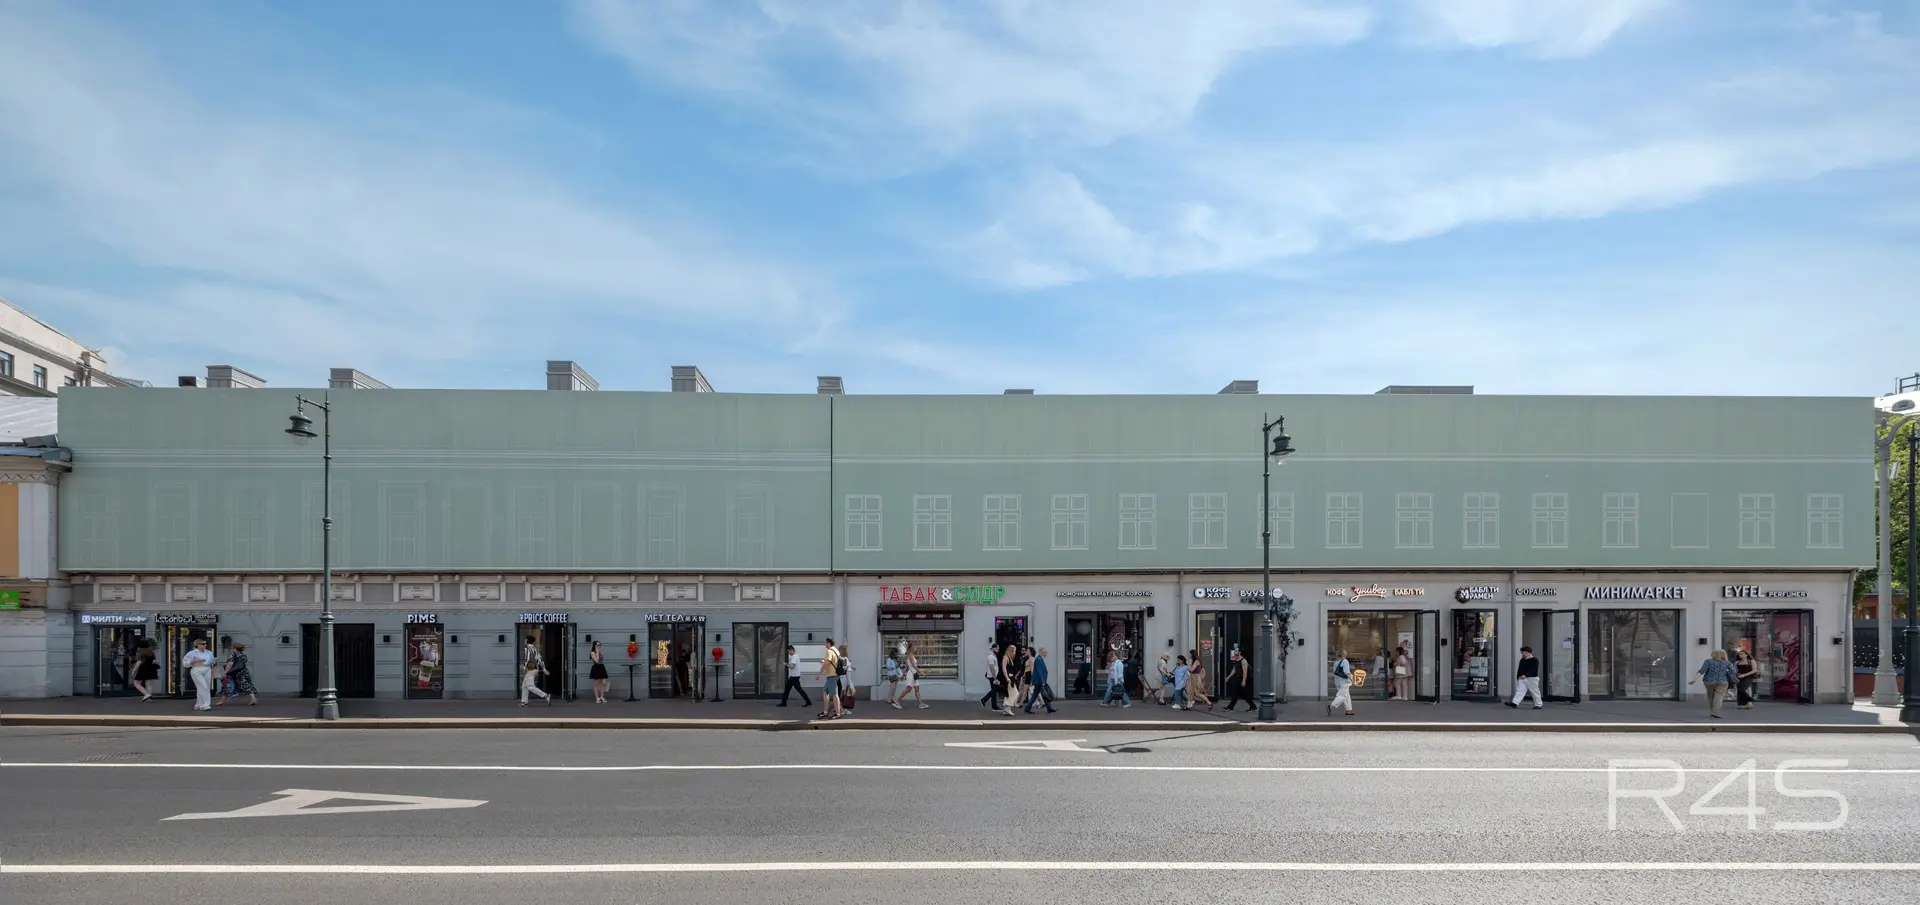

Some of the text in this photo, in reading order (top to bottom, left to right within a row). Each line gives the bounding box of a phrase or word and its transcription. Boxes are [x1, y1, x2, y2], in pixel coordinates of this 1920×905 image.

[880, 585, 1006, 604] ТАБАК & СИДР
[1327, 588, 1346, 596] КОФЕ
[1394, 588, 1425, 596] БАБЛ ТИ
[1516, 587, 1558, 596] ФОРАБАНК
[1586, 586, 1687, 598] МИНИМАРКЕТ
[1724, 586, 1766, 598] EYFEL
[91, 615, 122, 623] МИЛТИ
[407, 614, 436, 623] PIMS
[524, 613, 568, 623] PRICE COFFEE
[644, 614, 664, 622] MET
[666, 614, 684, 622] TEA
